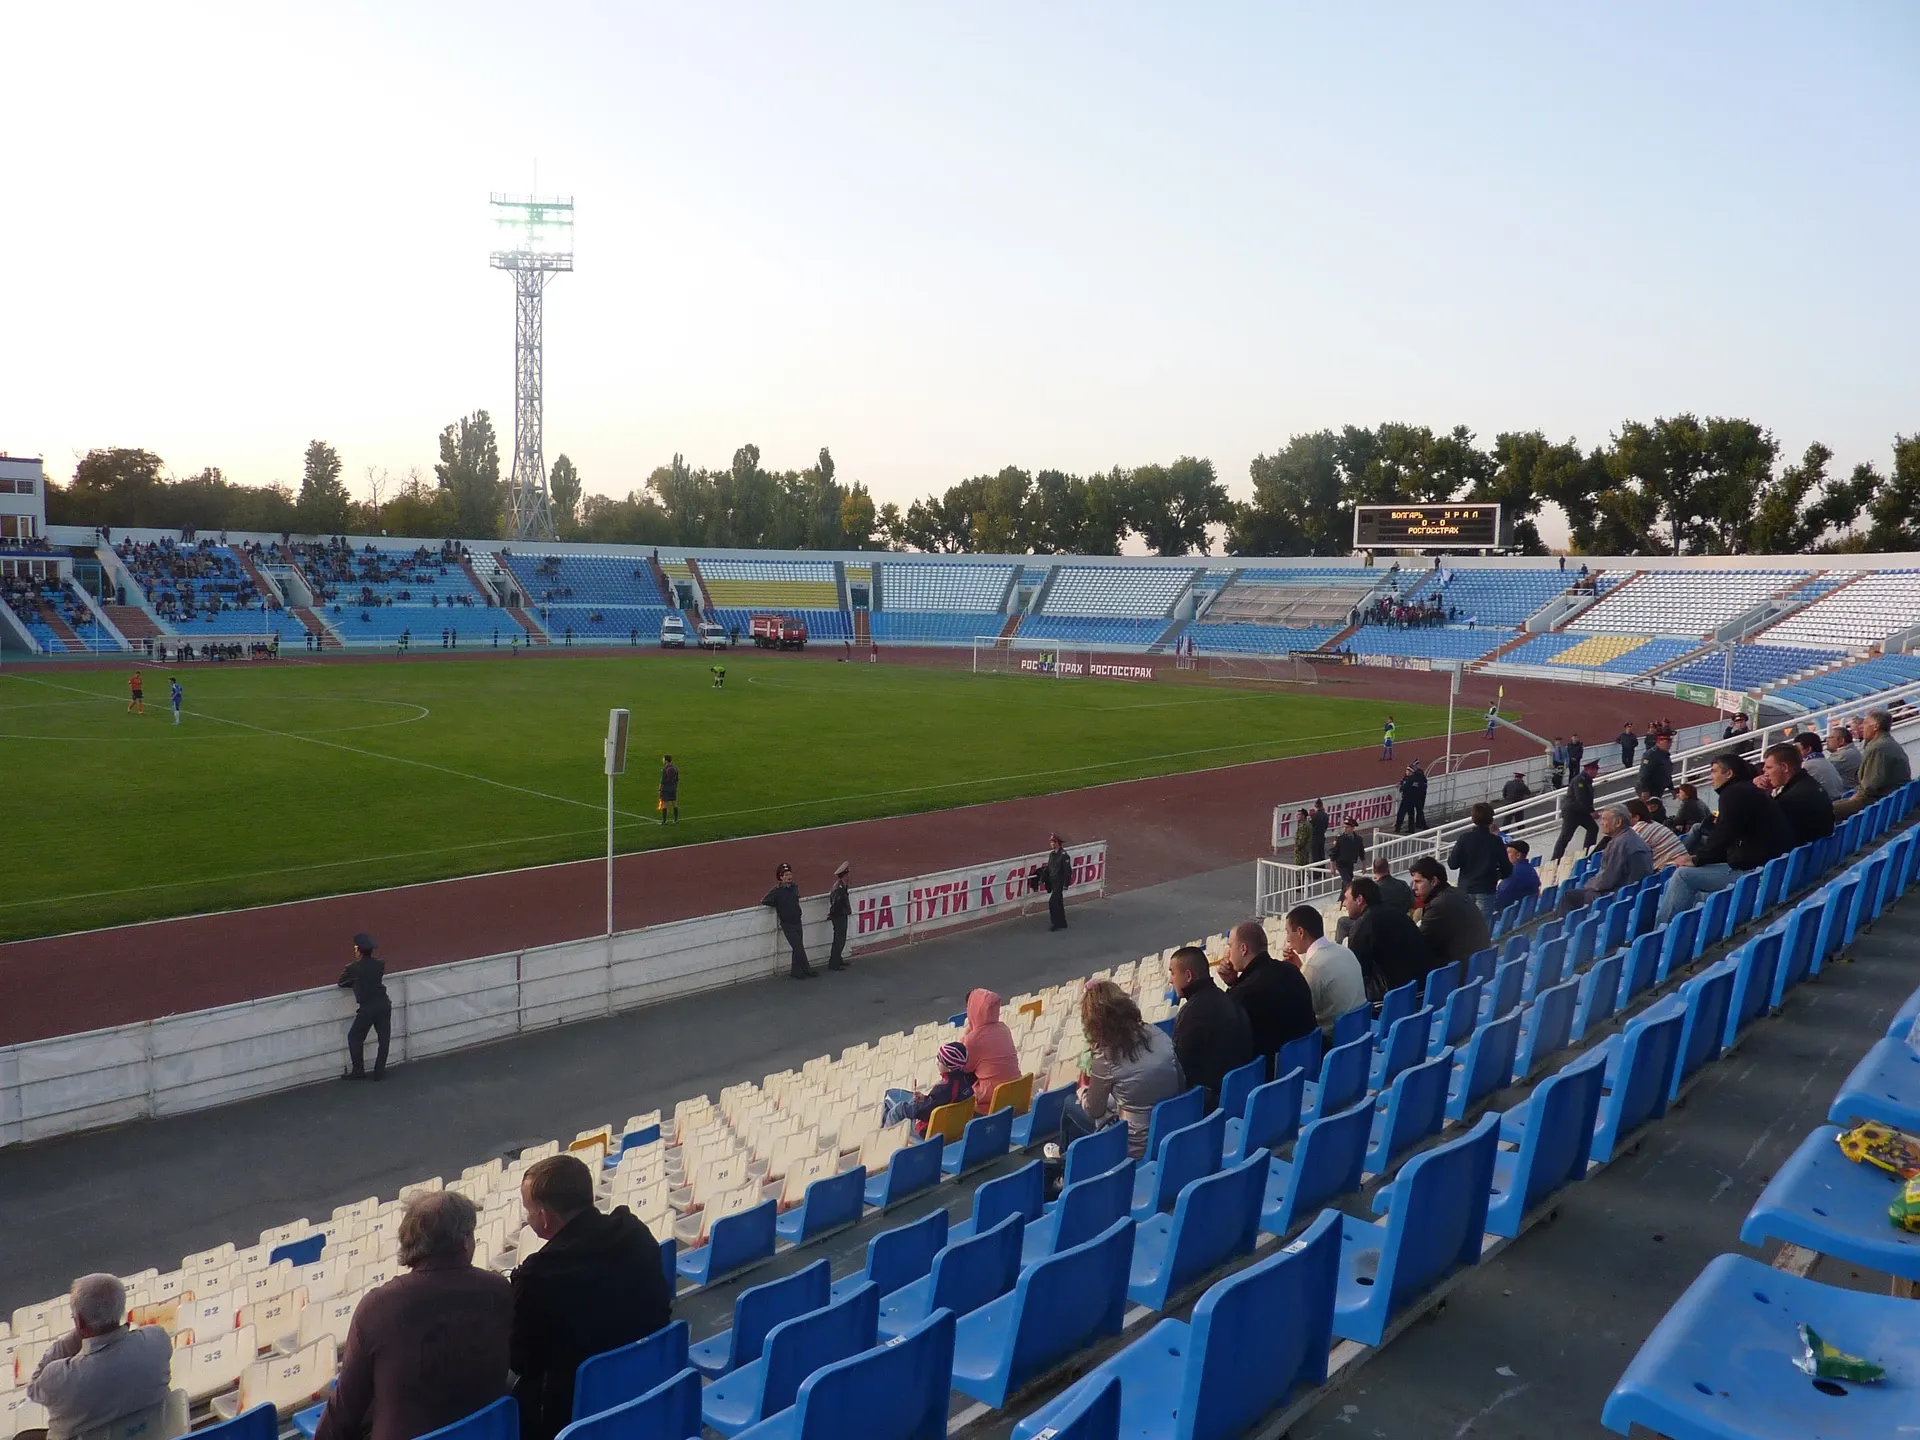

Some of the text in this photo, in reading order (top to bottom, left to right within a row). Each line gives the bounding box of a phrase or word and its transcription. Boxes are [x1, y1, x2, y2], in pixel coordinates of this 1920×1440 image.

[1391, 511, 1424, 519] ВОЛГАРЬ
[1408, 526, 1459, 534] РОСГОССТРАХ
[1090, 664, 1152, 678] РОСГОССТРАХ
[858, 895, 894, 934] НА
[907, 880, 968, 924] ПУТИ
[980, 874, 997, 907] К
[204, 1306, 219, 1317] 32
[265, 1307, 281, 1319] 32
[334, 1305, 351, 1318] 32
